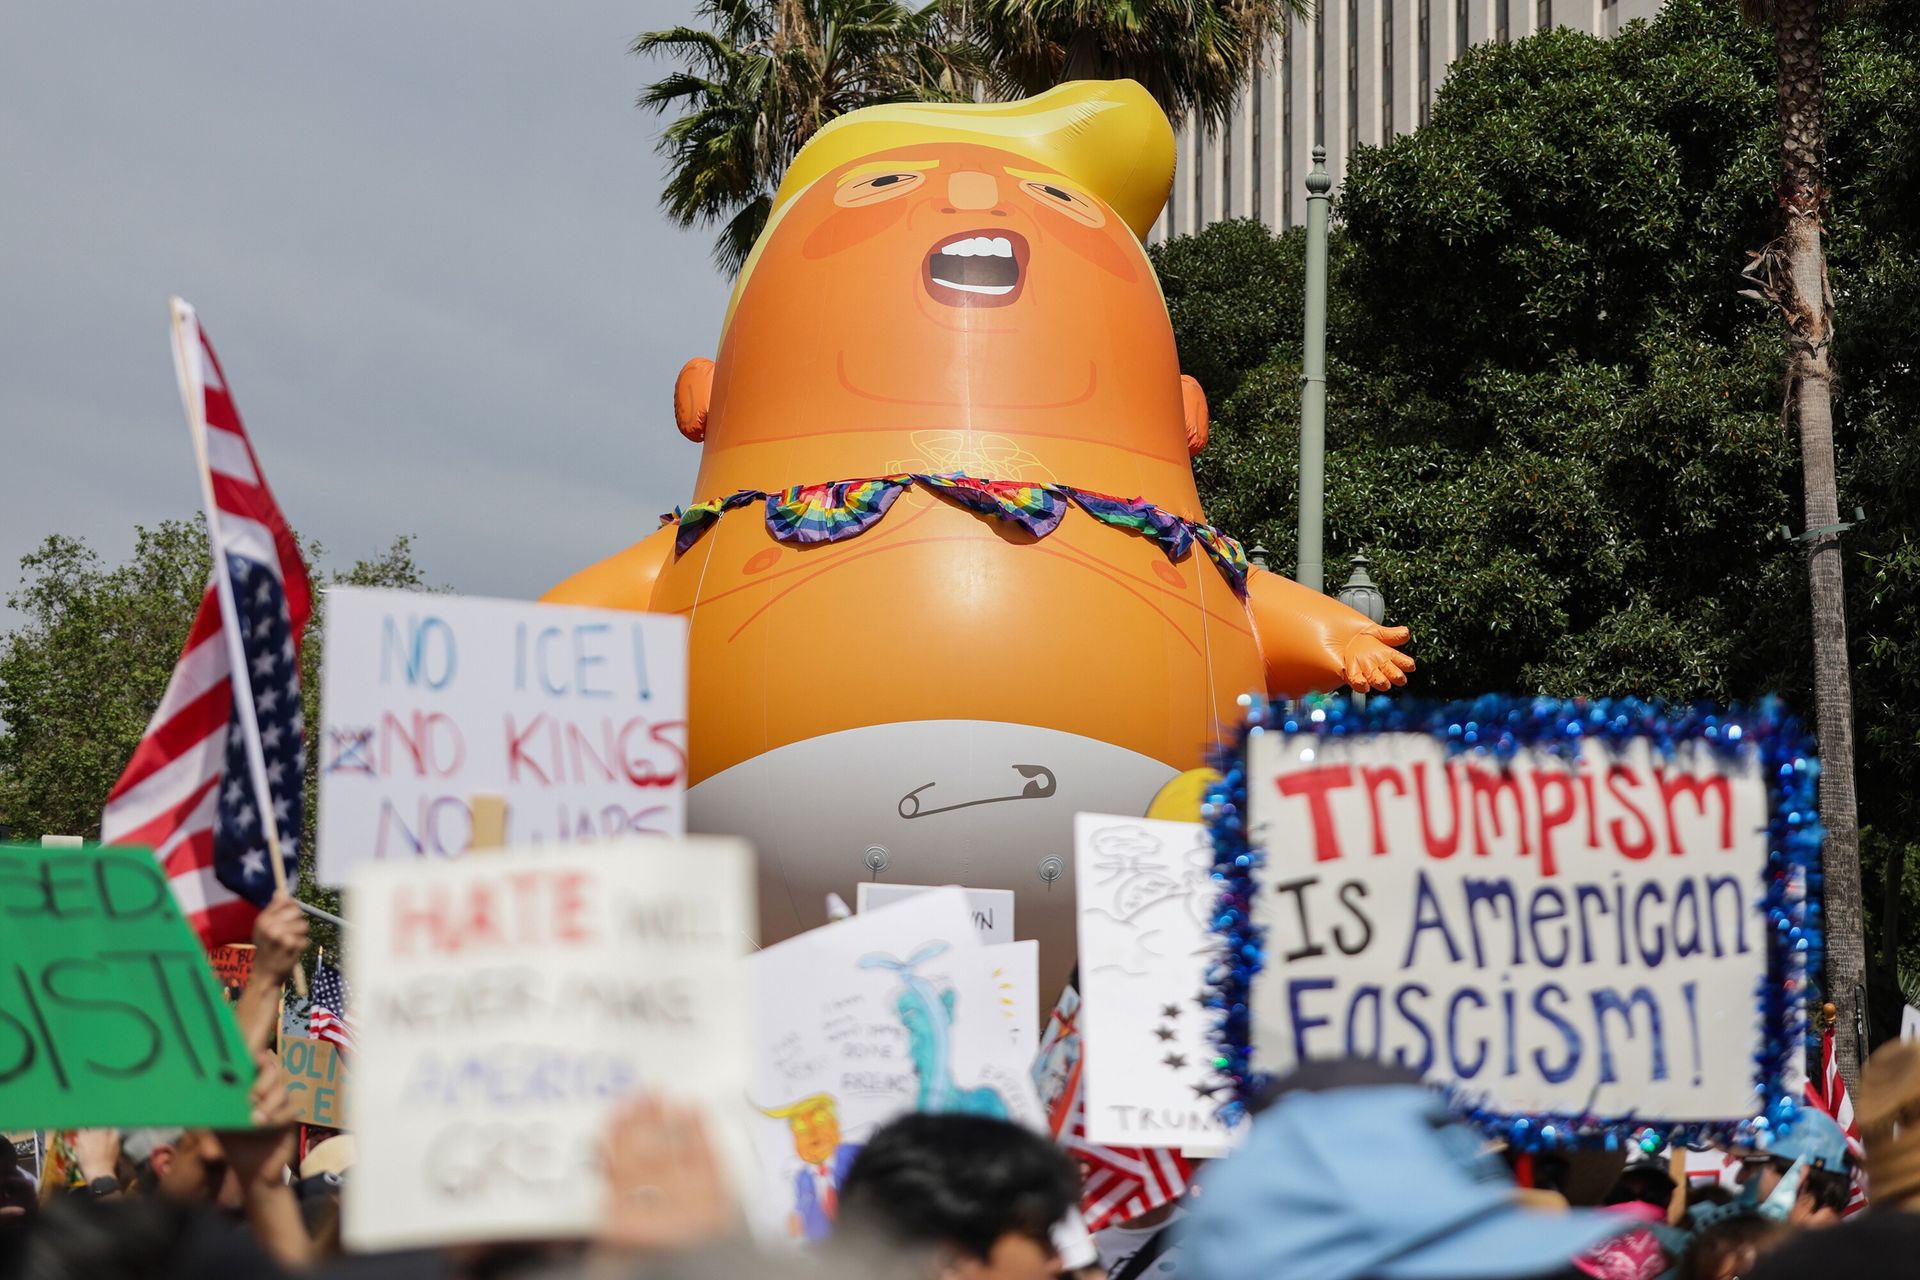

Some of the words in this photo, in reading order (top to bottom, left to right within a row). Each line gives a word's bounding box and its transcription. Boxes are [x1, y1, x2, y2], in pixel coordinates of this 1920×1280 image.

[379, 614, 458, 691] NO
[513, 622, 652, 700] ICE!
[379, 709, 465, 778] NO
[503, 711, 687, 788] KINGS
[374, 796, 475, 859] NO
[1274, 758, 1735, 877] Trumpism
[391, 870, 598, 958] HATE
[1401, 869, 1751, 969] American
[1285, 976, 1701, 1086] Fascism!
